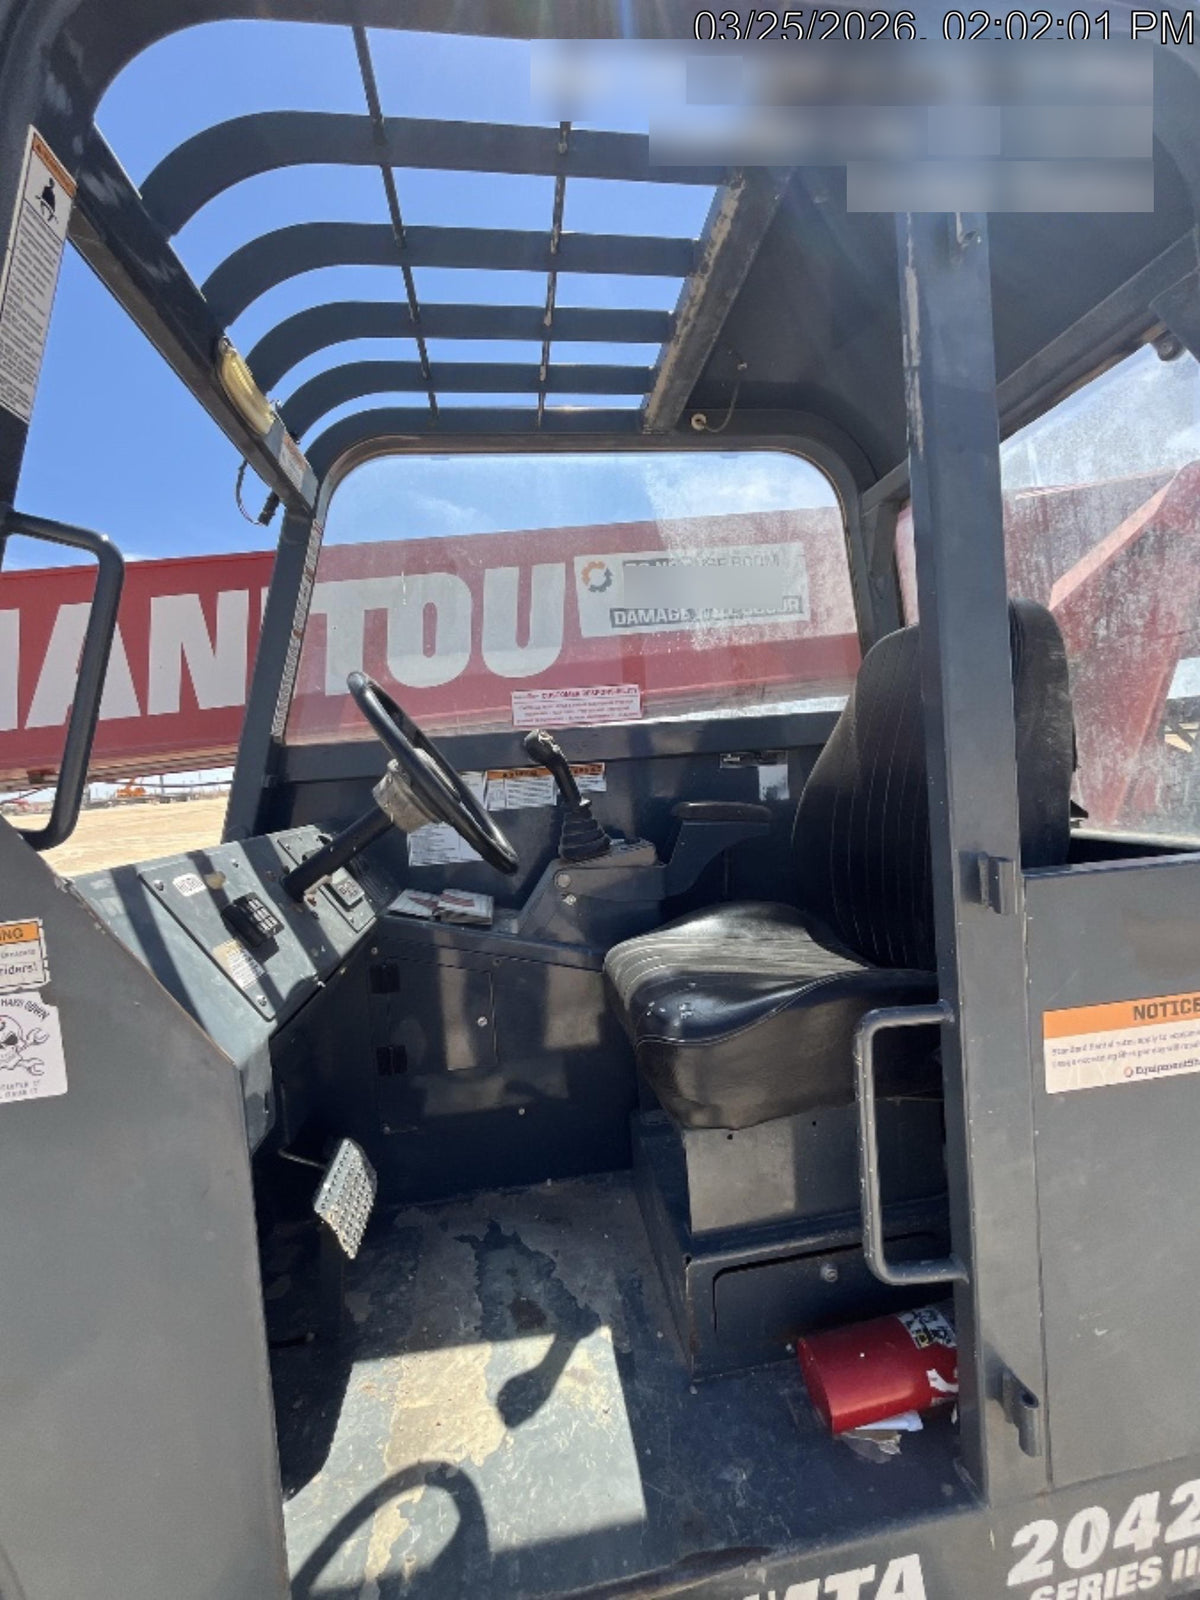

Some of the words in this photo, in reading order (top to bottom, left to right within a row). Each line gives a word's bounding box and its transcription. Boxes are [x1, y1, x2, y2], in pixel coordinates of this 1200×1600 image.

[0, 562, 566, 731] ANTOU
[1133, 997, 1200, 1021] NOTICE
[1007, 1478, 1200, 1587] 2042
[1171, 1545, 1200, 1583] II
